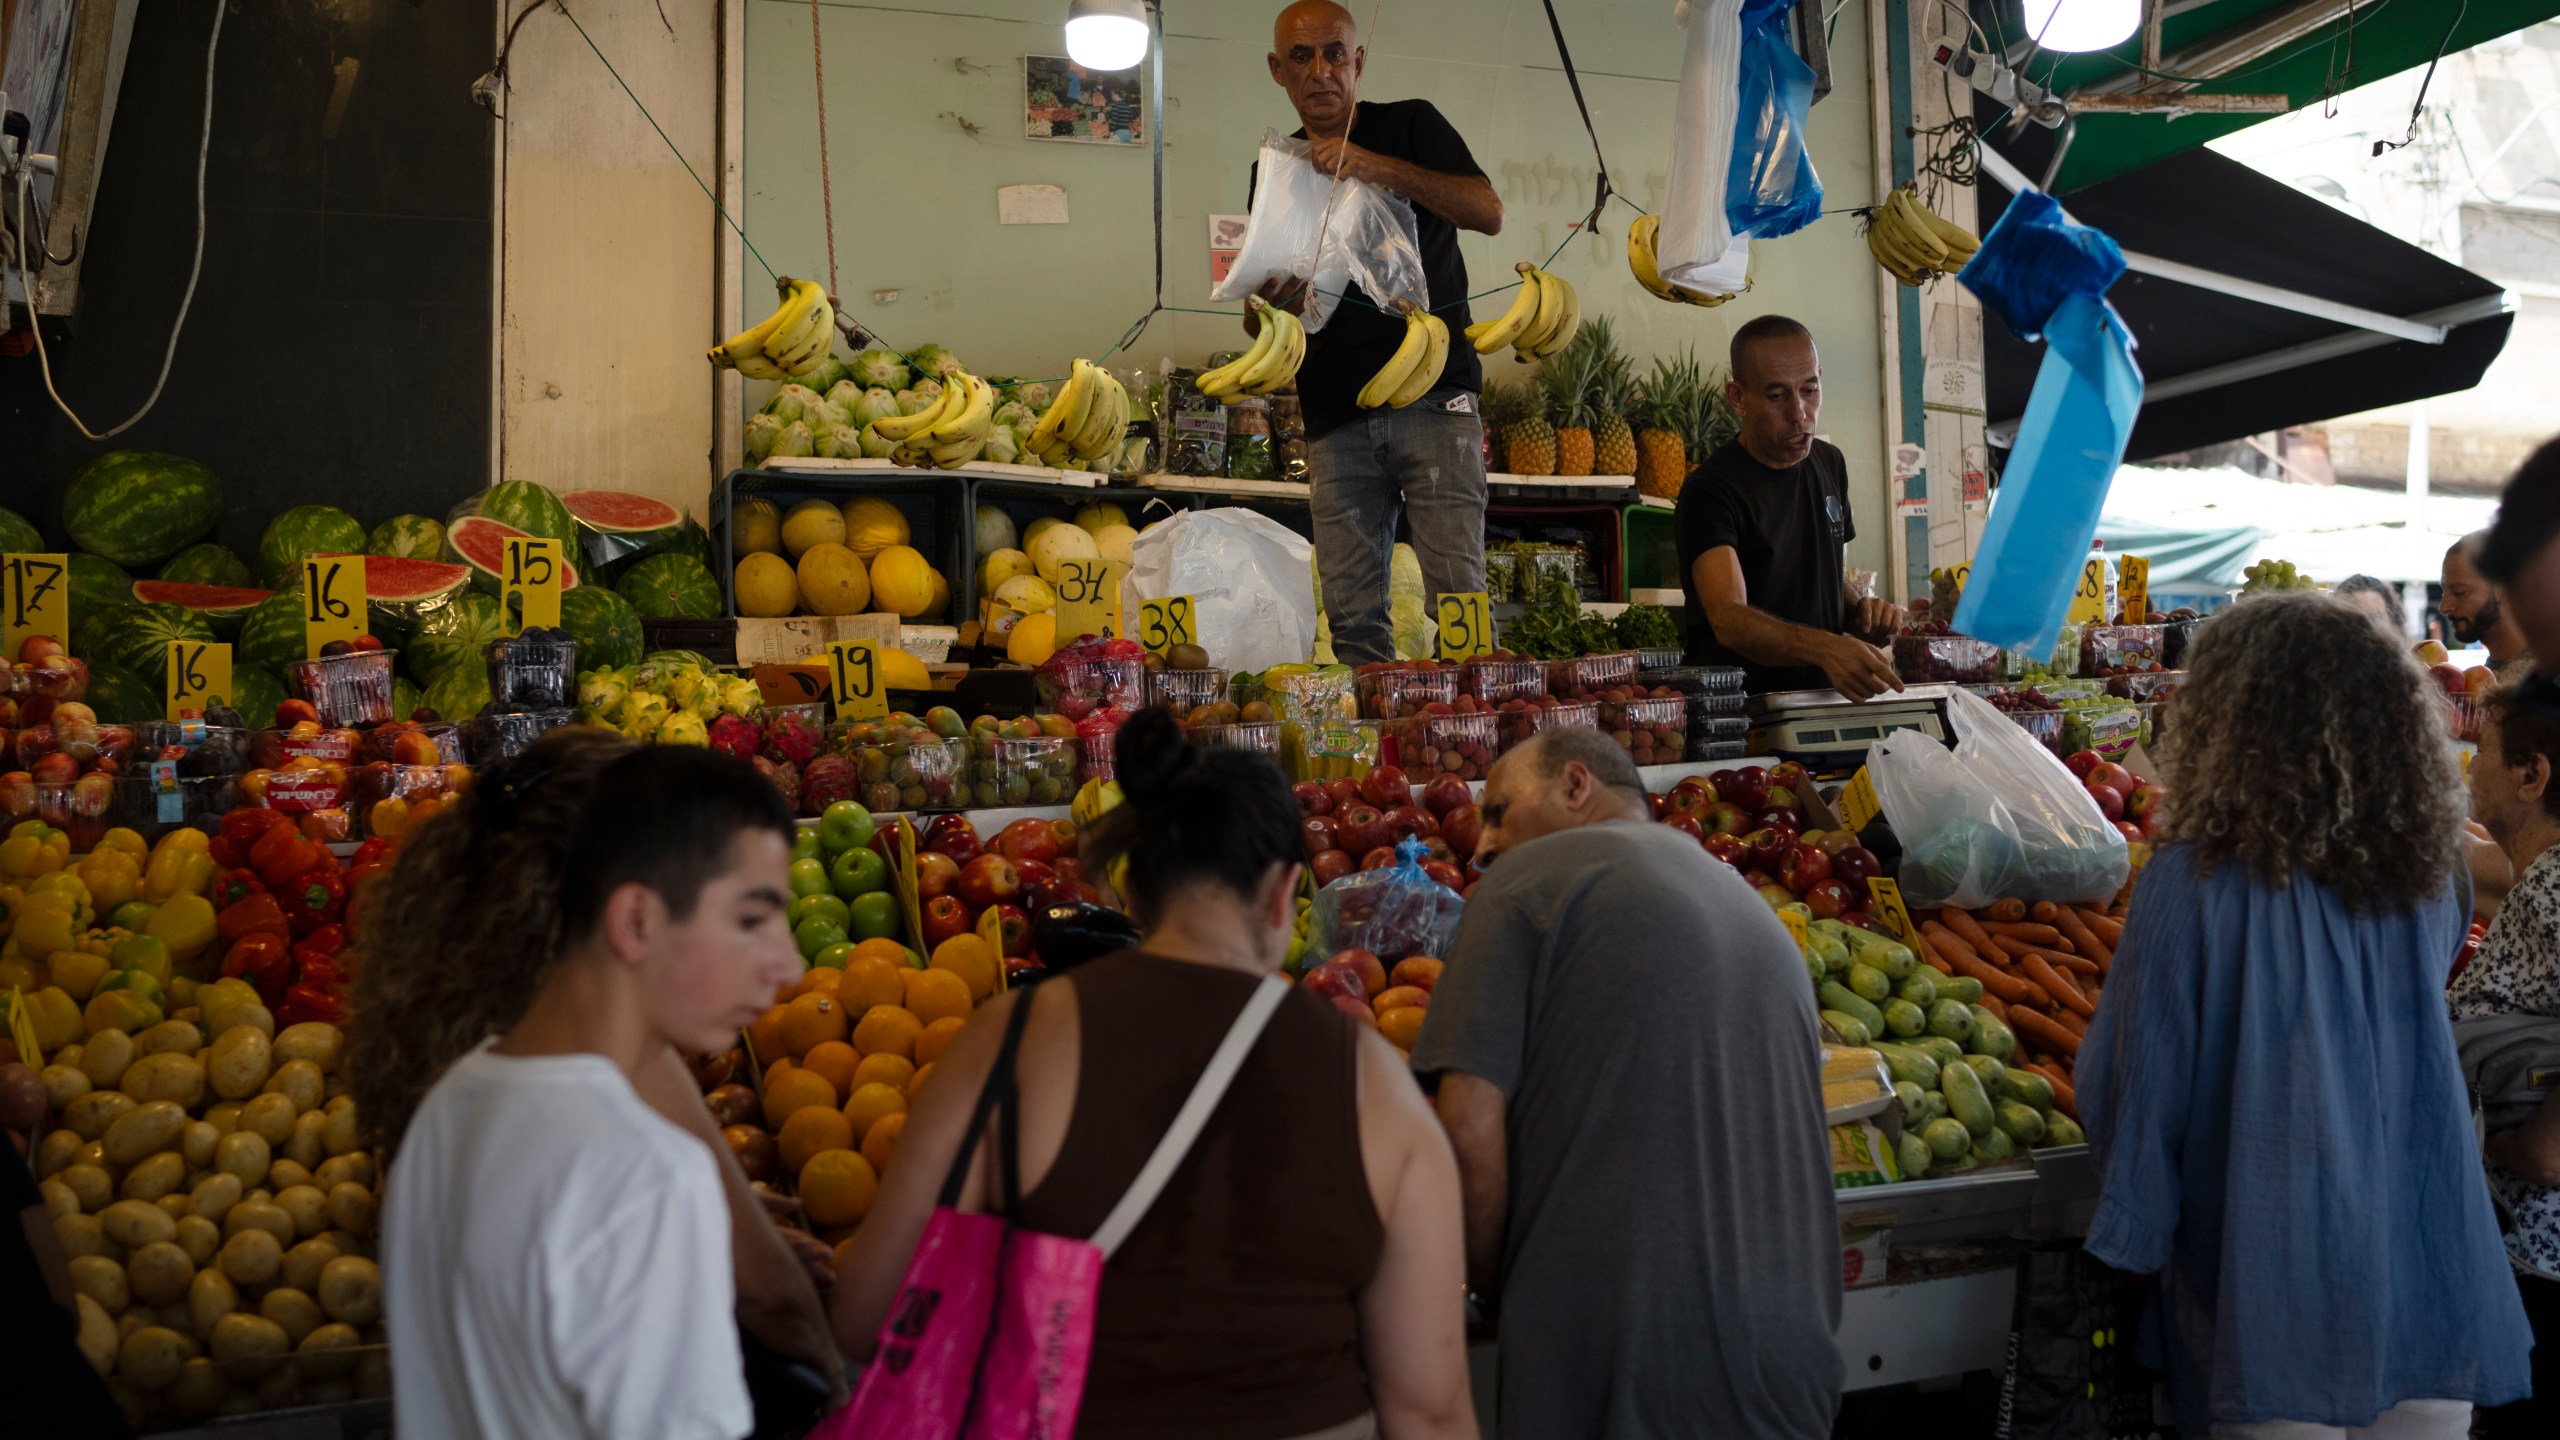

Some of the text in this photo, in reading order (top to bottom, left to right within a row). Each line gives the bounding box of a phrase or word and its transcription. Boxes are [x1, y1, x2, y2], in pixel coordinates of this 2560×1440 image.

[307, 562, 349, 622] 16
[508, 541, 552, 586] 15
[1059, 561, 1107, 604] 34
[3, 558, 63, 628] 17
[1142, 597, 1188, 650] 38
[1440, 596, 1487, 654] 31
[174, 644, 207, 700] 16
[832, 646, 874, 705] 19
